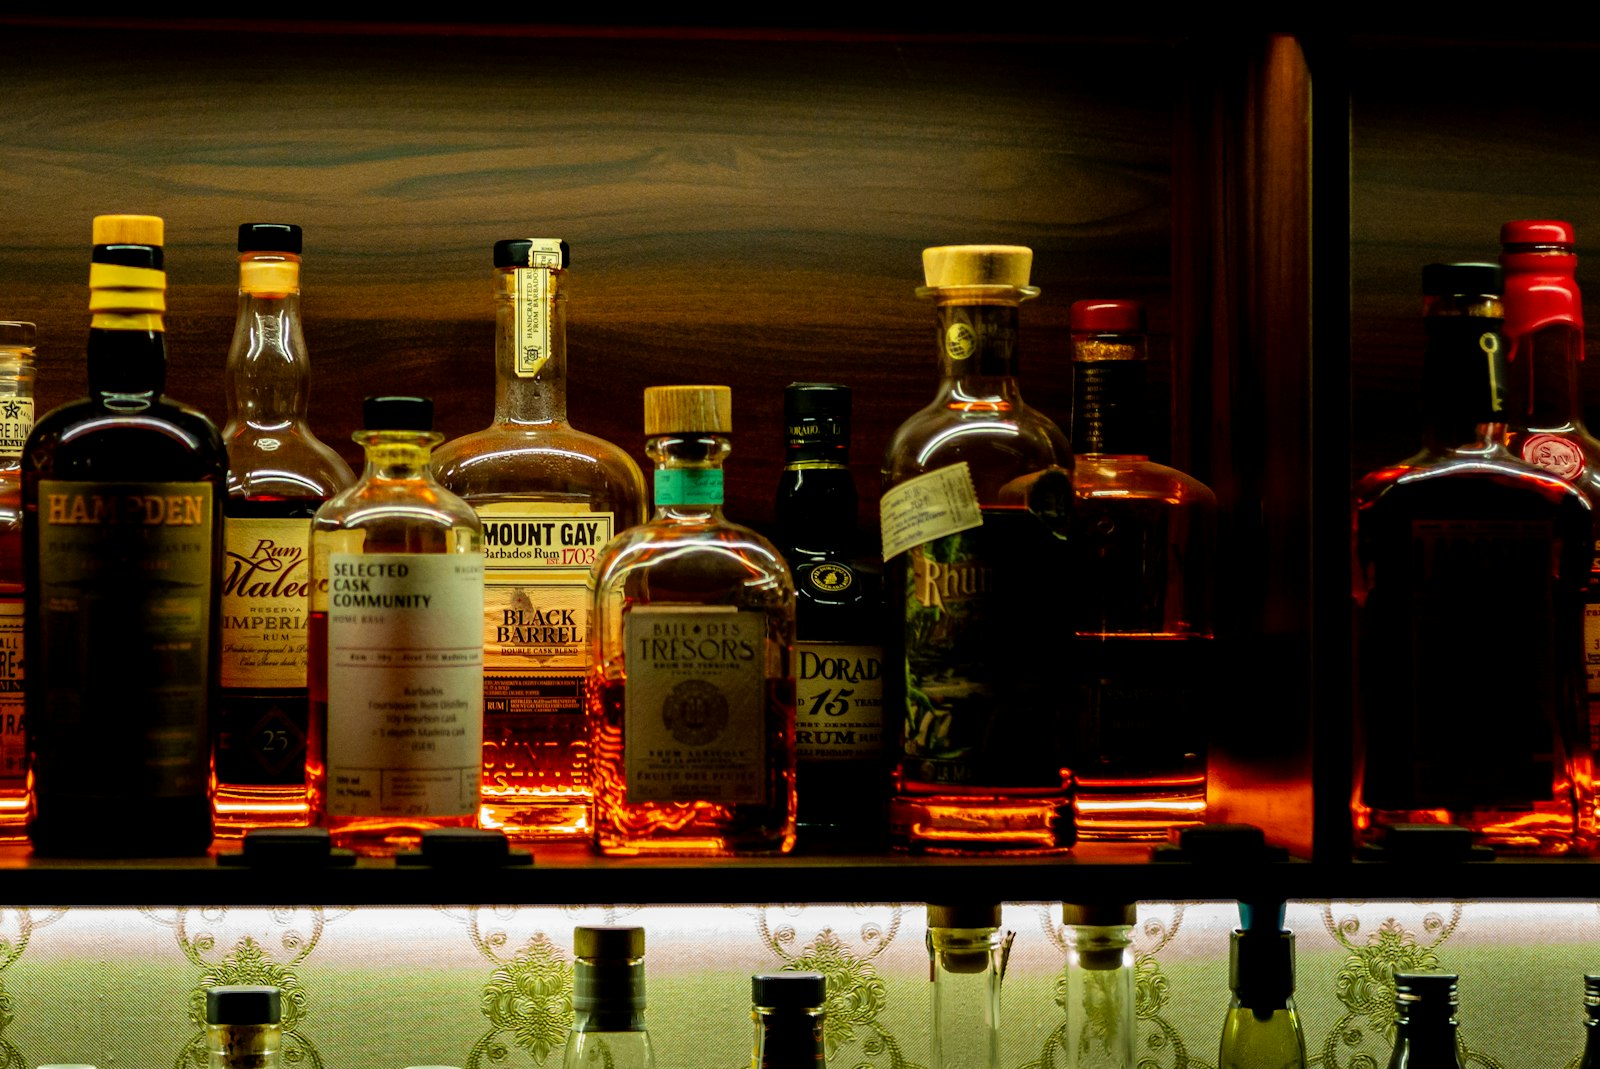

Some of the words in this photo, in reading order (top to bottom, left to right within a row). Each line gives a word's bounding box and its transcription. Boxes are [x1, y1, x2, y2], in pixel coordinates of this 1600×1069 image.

[47, 494, 203, 526] HAMPDEN
[482, 523, 556, 546] MOUNT
[561, 523, 599, 546] GAY
[250, 538, 302, 568] Rum
[484, 548, 532, 559] Barbados
[534, 548, 560, 559] Rum
[561, 548, 596, 565] 1703
[333, 562, 409, 578] SELECTED
[333, 579, 370, 592] CASK
[333, 594, 432, 609] COMMUNITY
[223, 616, 310, 630] IMPERIA
[503, 609, 576, 626] BLACK
[262, 633, 290, 642] RUM
[497, 626, 583, 643] BARREL
[706, 623, 741, 636] DES
[799, 651, 881, 684] DORAD
[487, 701, 505, 711] RUM
[808, 688, 855, 717] 15
[262, 729, 289, 751] 25
[796, 730, 857, 745] RUM
